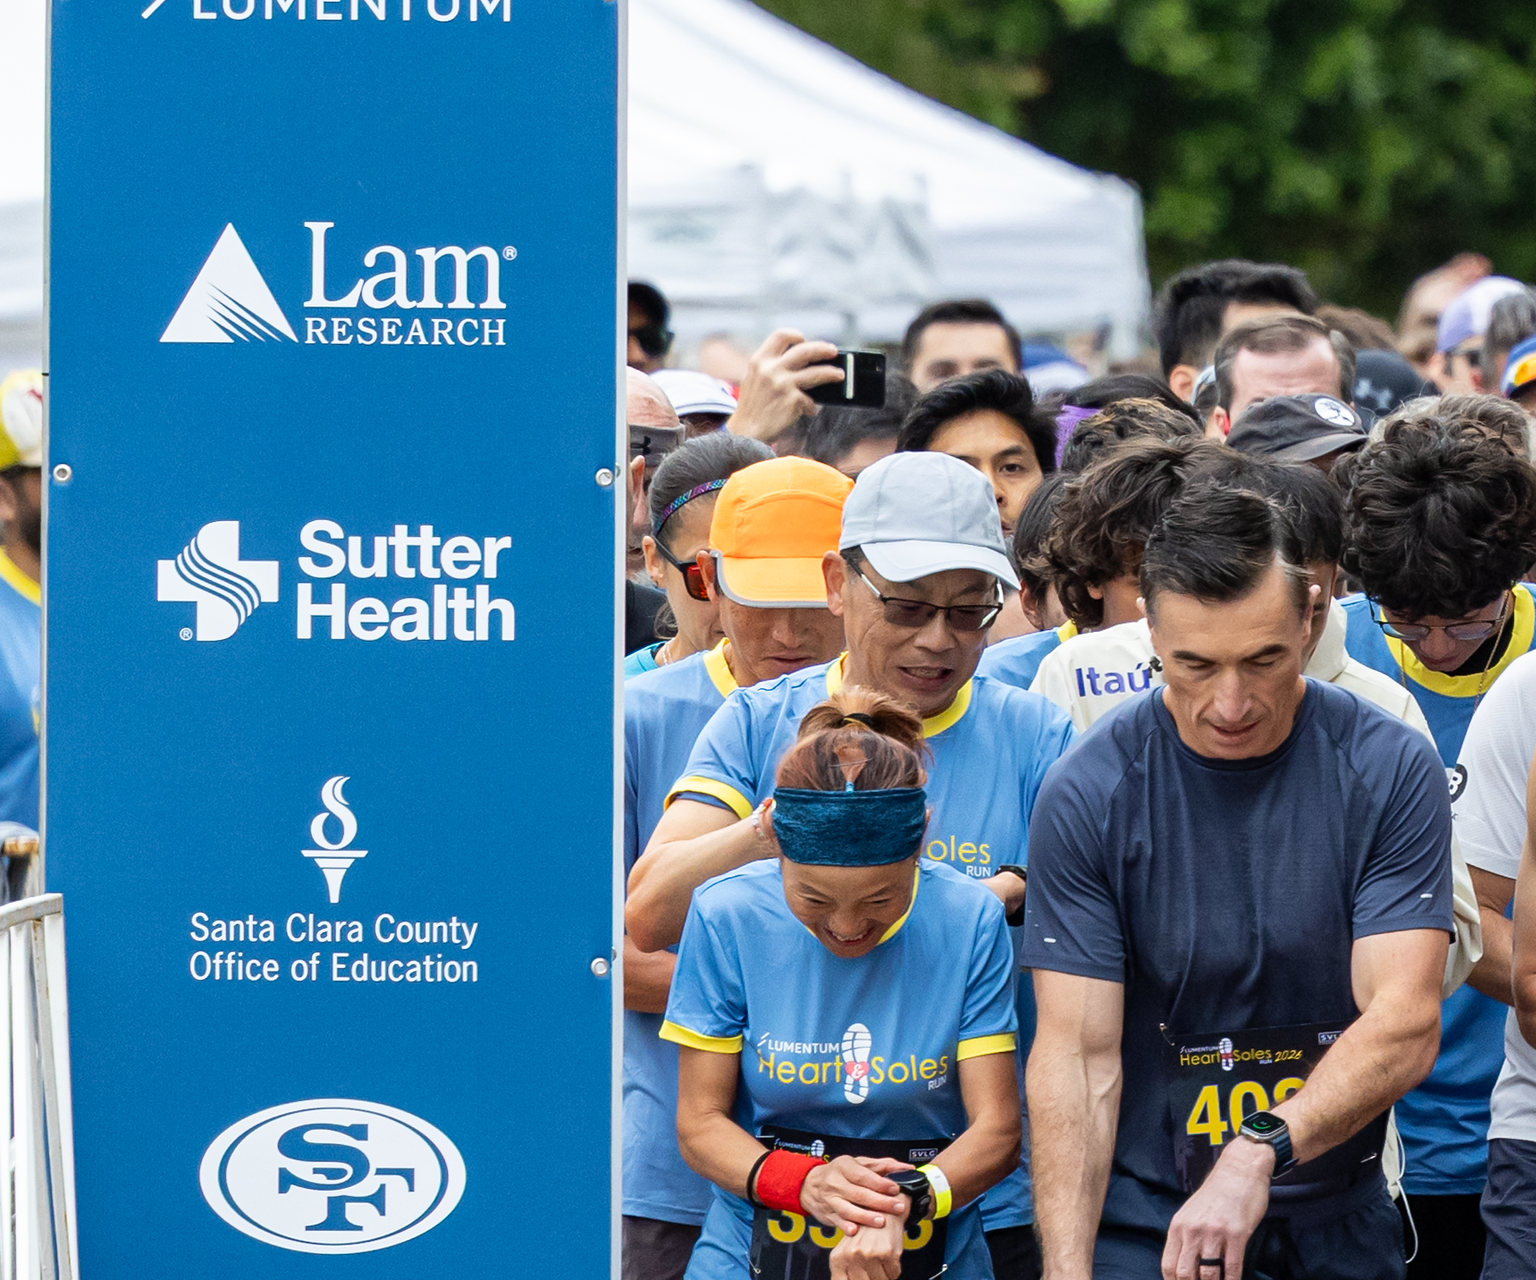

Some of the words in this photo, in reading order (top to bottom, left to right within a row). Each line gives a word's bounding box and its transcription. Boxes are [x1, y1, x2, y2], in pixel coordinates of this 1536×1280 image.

[306, 319, 505, 346] RESEARCH
[300, 521, 512, 580] Sutter
[298, 584, 515, 641] Health
[1075, 662, 1152, 698] Itaú
[926, 835, 991, 865] oles
[966, 865, 992, 878] RUN
[192, 914, 275, 942] Santa
[288, 914, 363, 943] Clara
[376, 915, 478, 950] County
[191, 952, 280, 981] Office
[292, 954, 320, 982] of
[334, 954, 478, 983] Education
[768, 1038, 841, 1055] LUMENTUM
[1180, 1051, 1221, 1067] Heart
[1233, 1048, 1272, 1063] Soles
[758, 1046, 844, 1086] Heart
[871, 1054, 949, 1085] Soles
[928, 1075, 948, 1091] RUN
